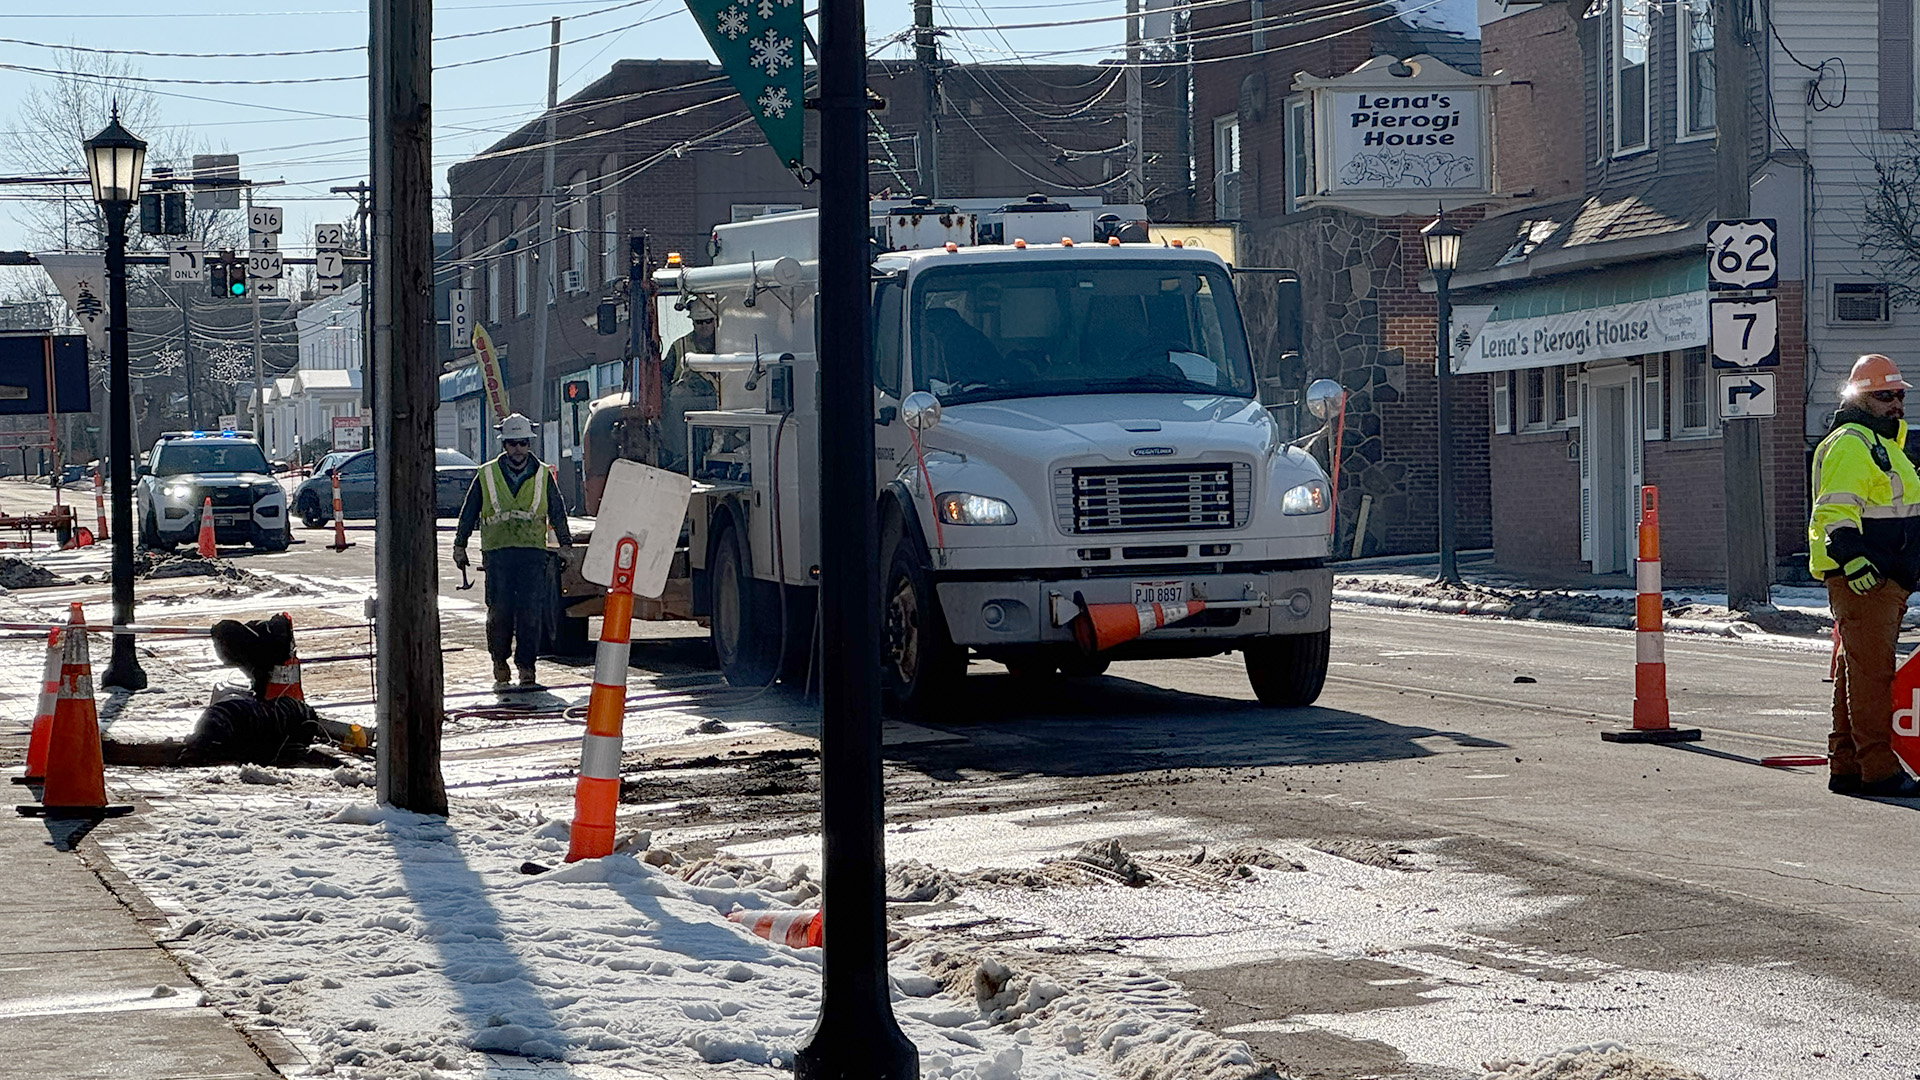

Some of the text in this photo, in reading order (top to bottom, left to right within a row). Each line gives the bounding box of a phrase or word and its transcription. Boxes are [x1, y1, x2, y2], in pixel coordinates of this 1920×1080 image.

[1358, 93, 1451, 109] Lena's
[1350, 110, 1460, 132] Pierogi
[1363, 131, 1455, 146] House
[253, 213, 278, 225] 616
[317, 229, 340, 244] 62
[1717, 234, 1770, 274] 62
[251, 257, 281, 271] 304
[324, 257, 335, 272] 7
[174, 270, 201, 279] ONLY
[1481, 318, 1649, 359] Lena's Pierogi House
[1732, 313, 1758, 350] 7
[1135, 587, 1182, 603] PJD 8897
